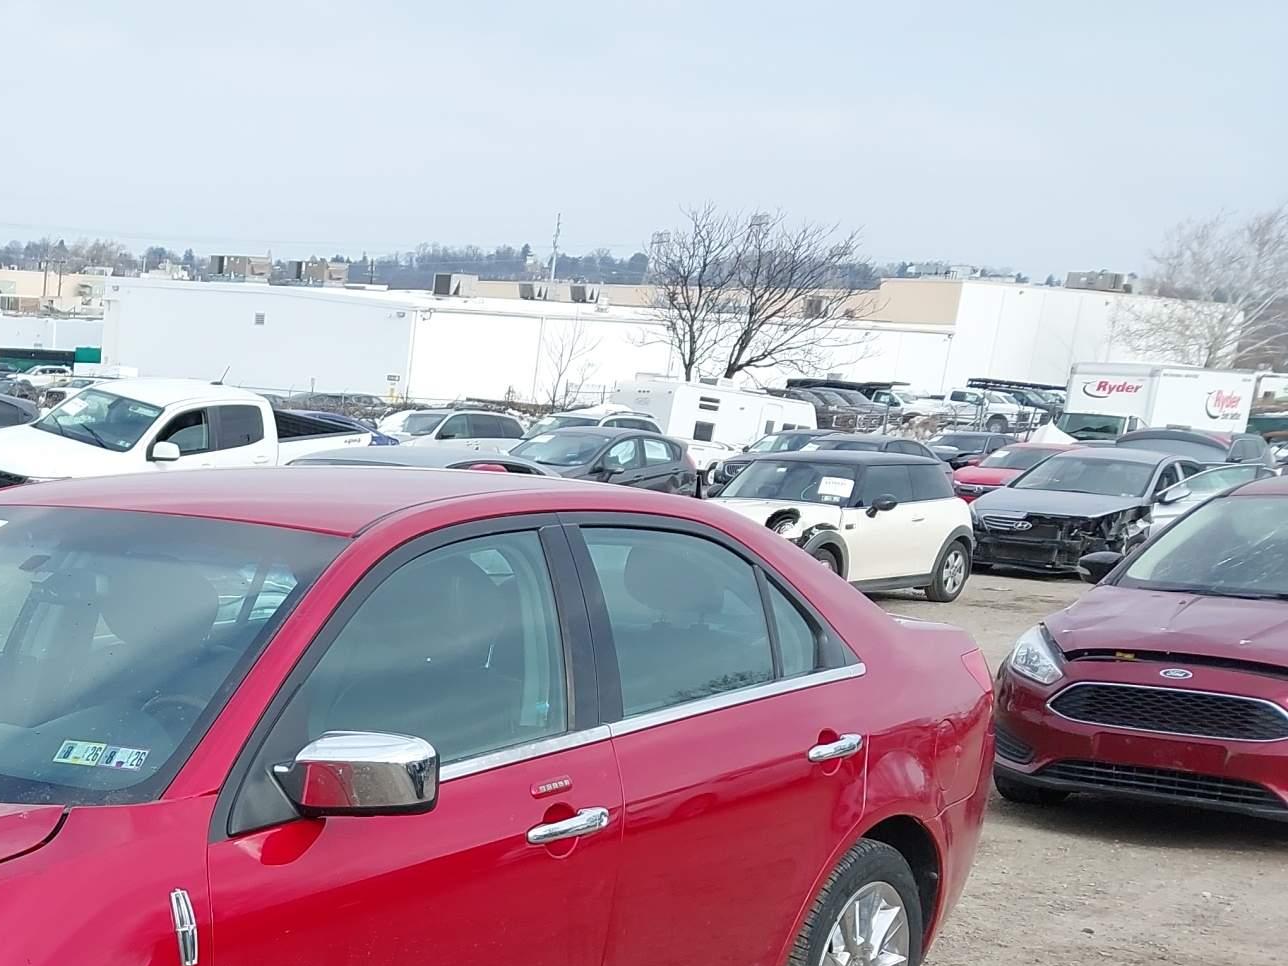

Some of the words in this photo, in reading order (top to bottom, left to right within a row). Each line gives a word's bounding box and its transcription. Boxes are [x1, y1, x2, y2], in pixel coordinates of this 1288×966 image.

[1096, 381, 1143, 394] Ryder
[1213, 390, 1241, 412] Ryder
[130, 751, 145, 767] 26
